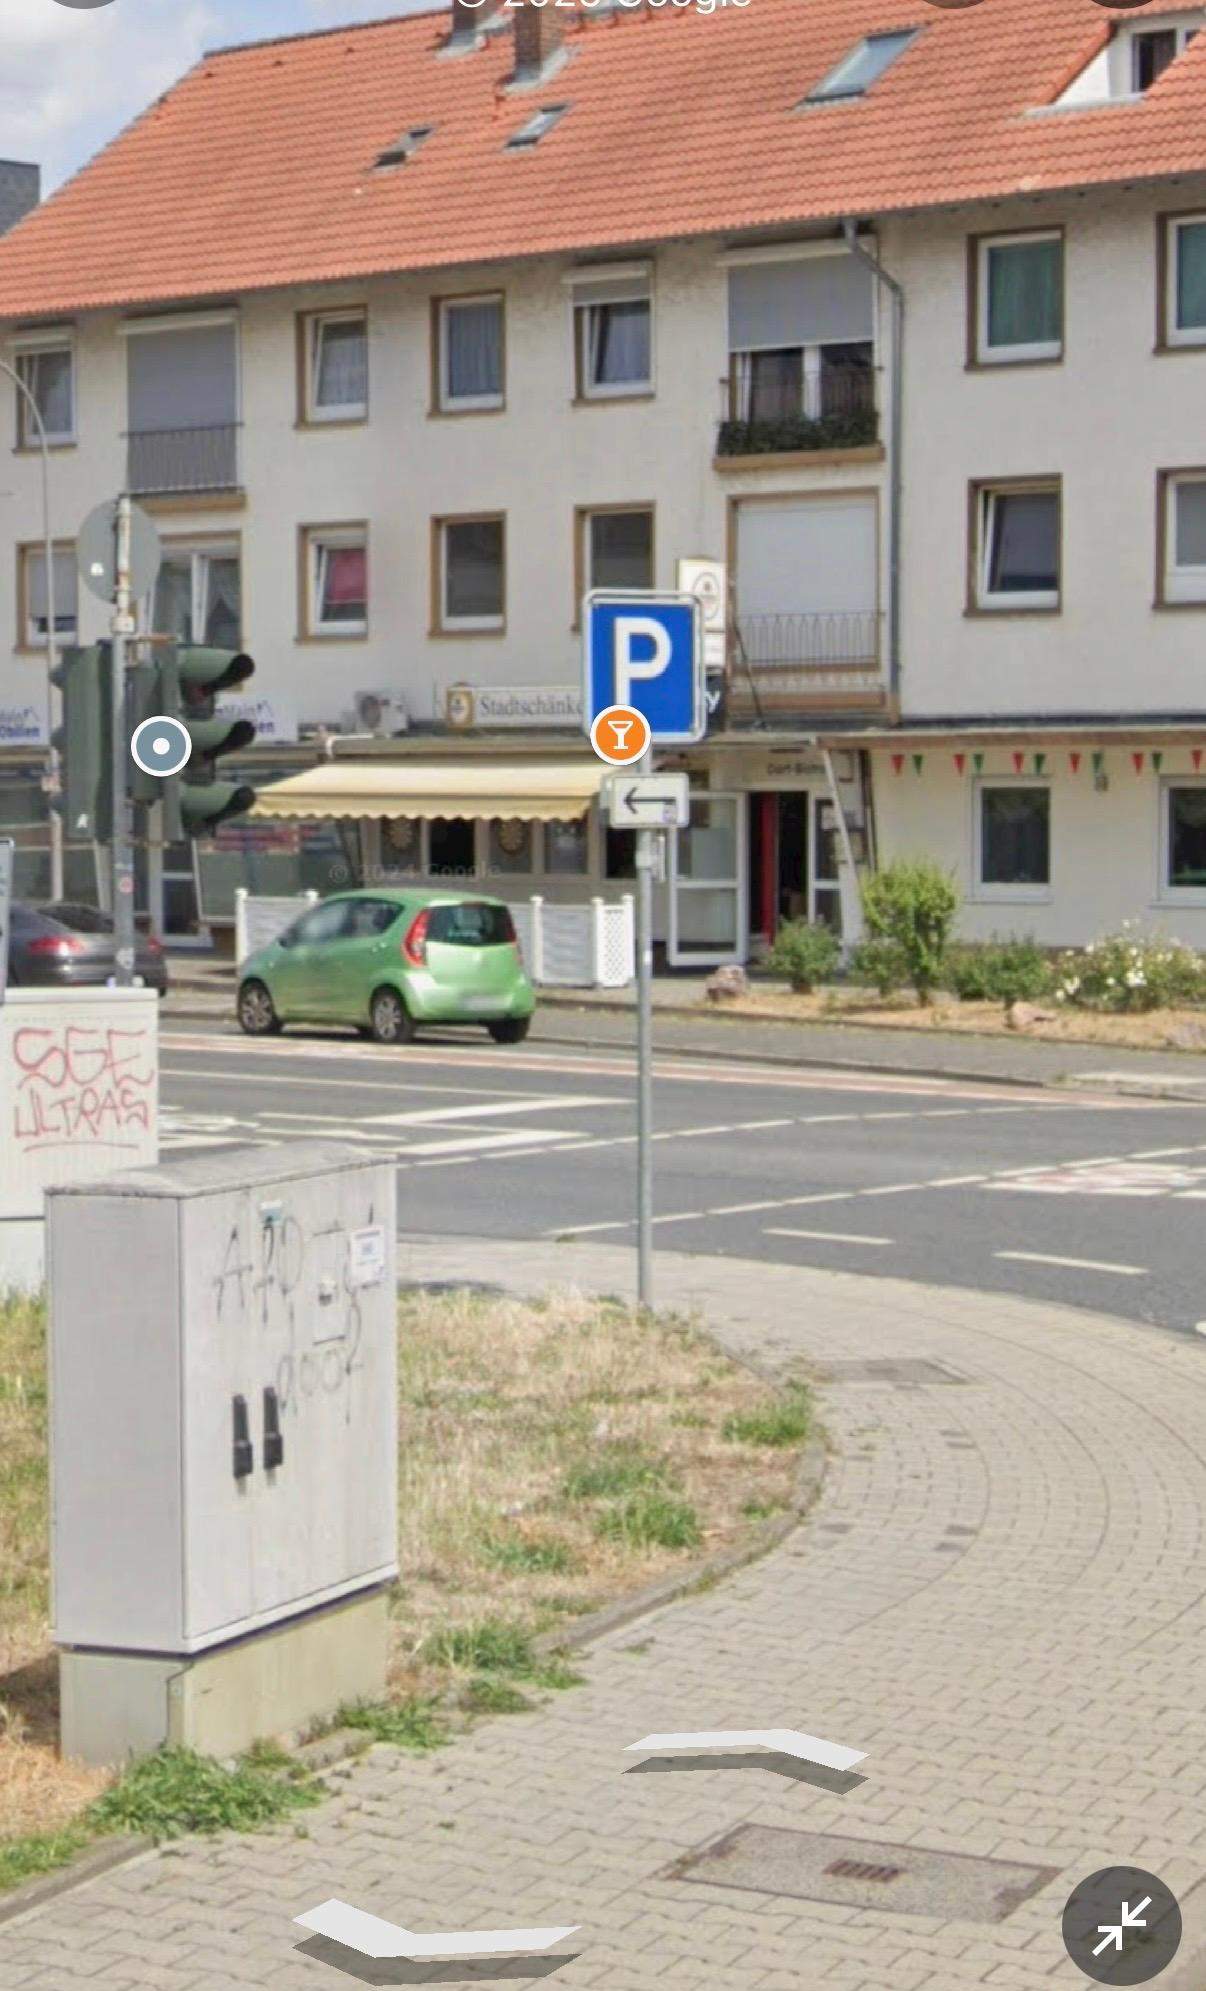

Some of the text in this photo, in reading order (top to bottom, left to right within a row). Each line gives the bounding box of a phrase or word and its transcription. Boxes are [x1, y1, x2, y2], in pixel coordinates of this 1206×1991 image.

[614, 617, 672, 706] P
[13, 1026, 155, 1090] SGE
[14, 1087, 149, 1138] ULTRAS
